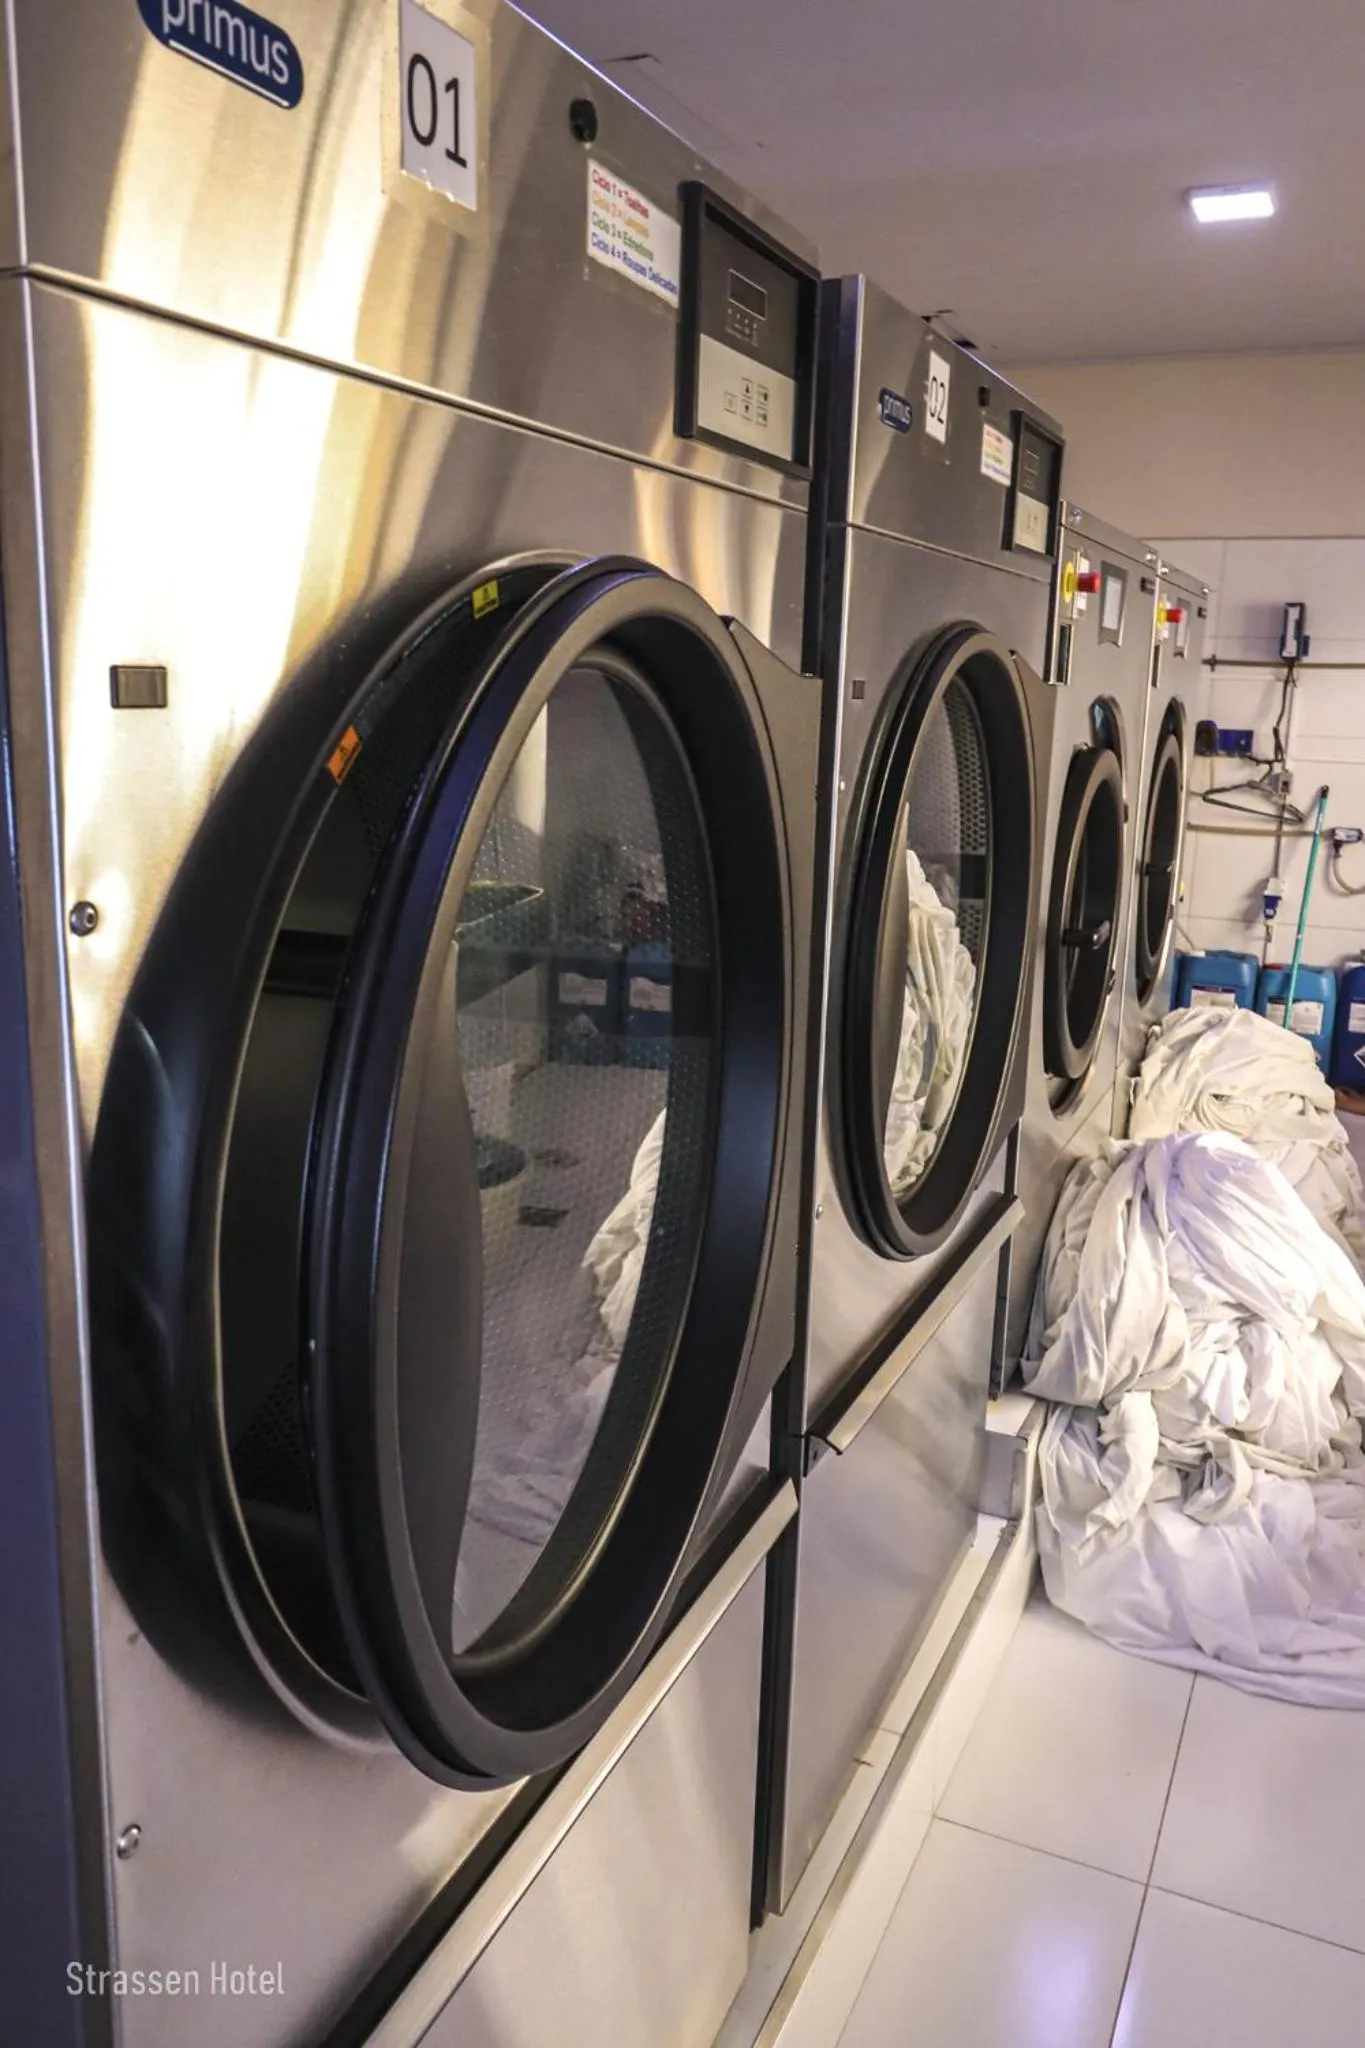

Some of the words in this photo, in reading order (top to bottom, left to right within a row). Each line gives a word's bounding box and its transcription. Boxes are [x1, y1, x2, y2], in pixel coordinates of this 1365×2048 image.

[162, 0, 290, 85] primus
[407, 53, 468, 169] 01
[929, 376, 946, 425] 02
